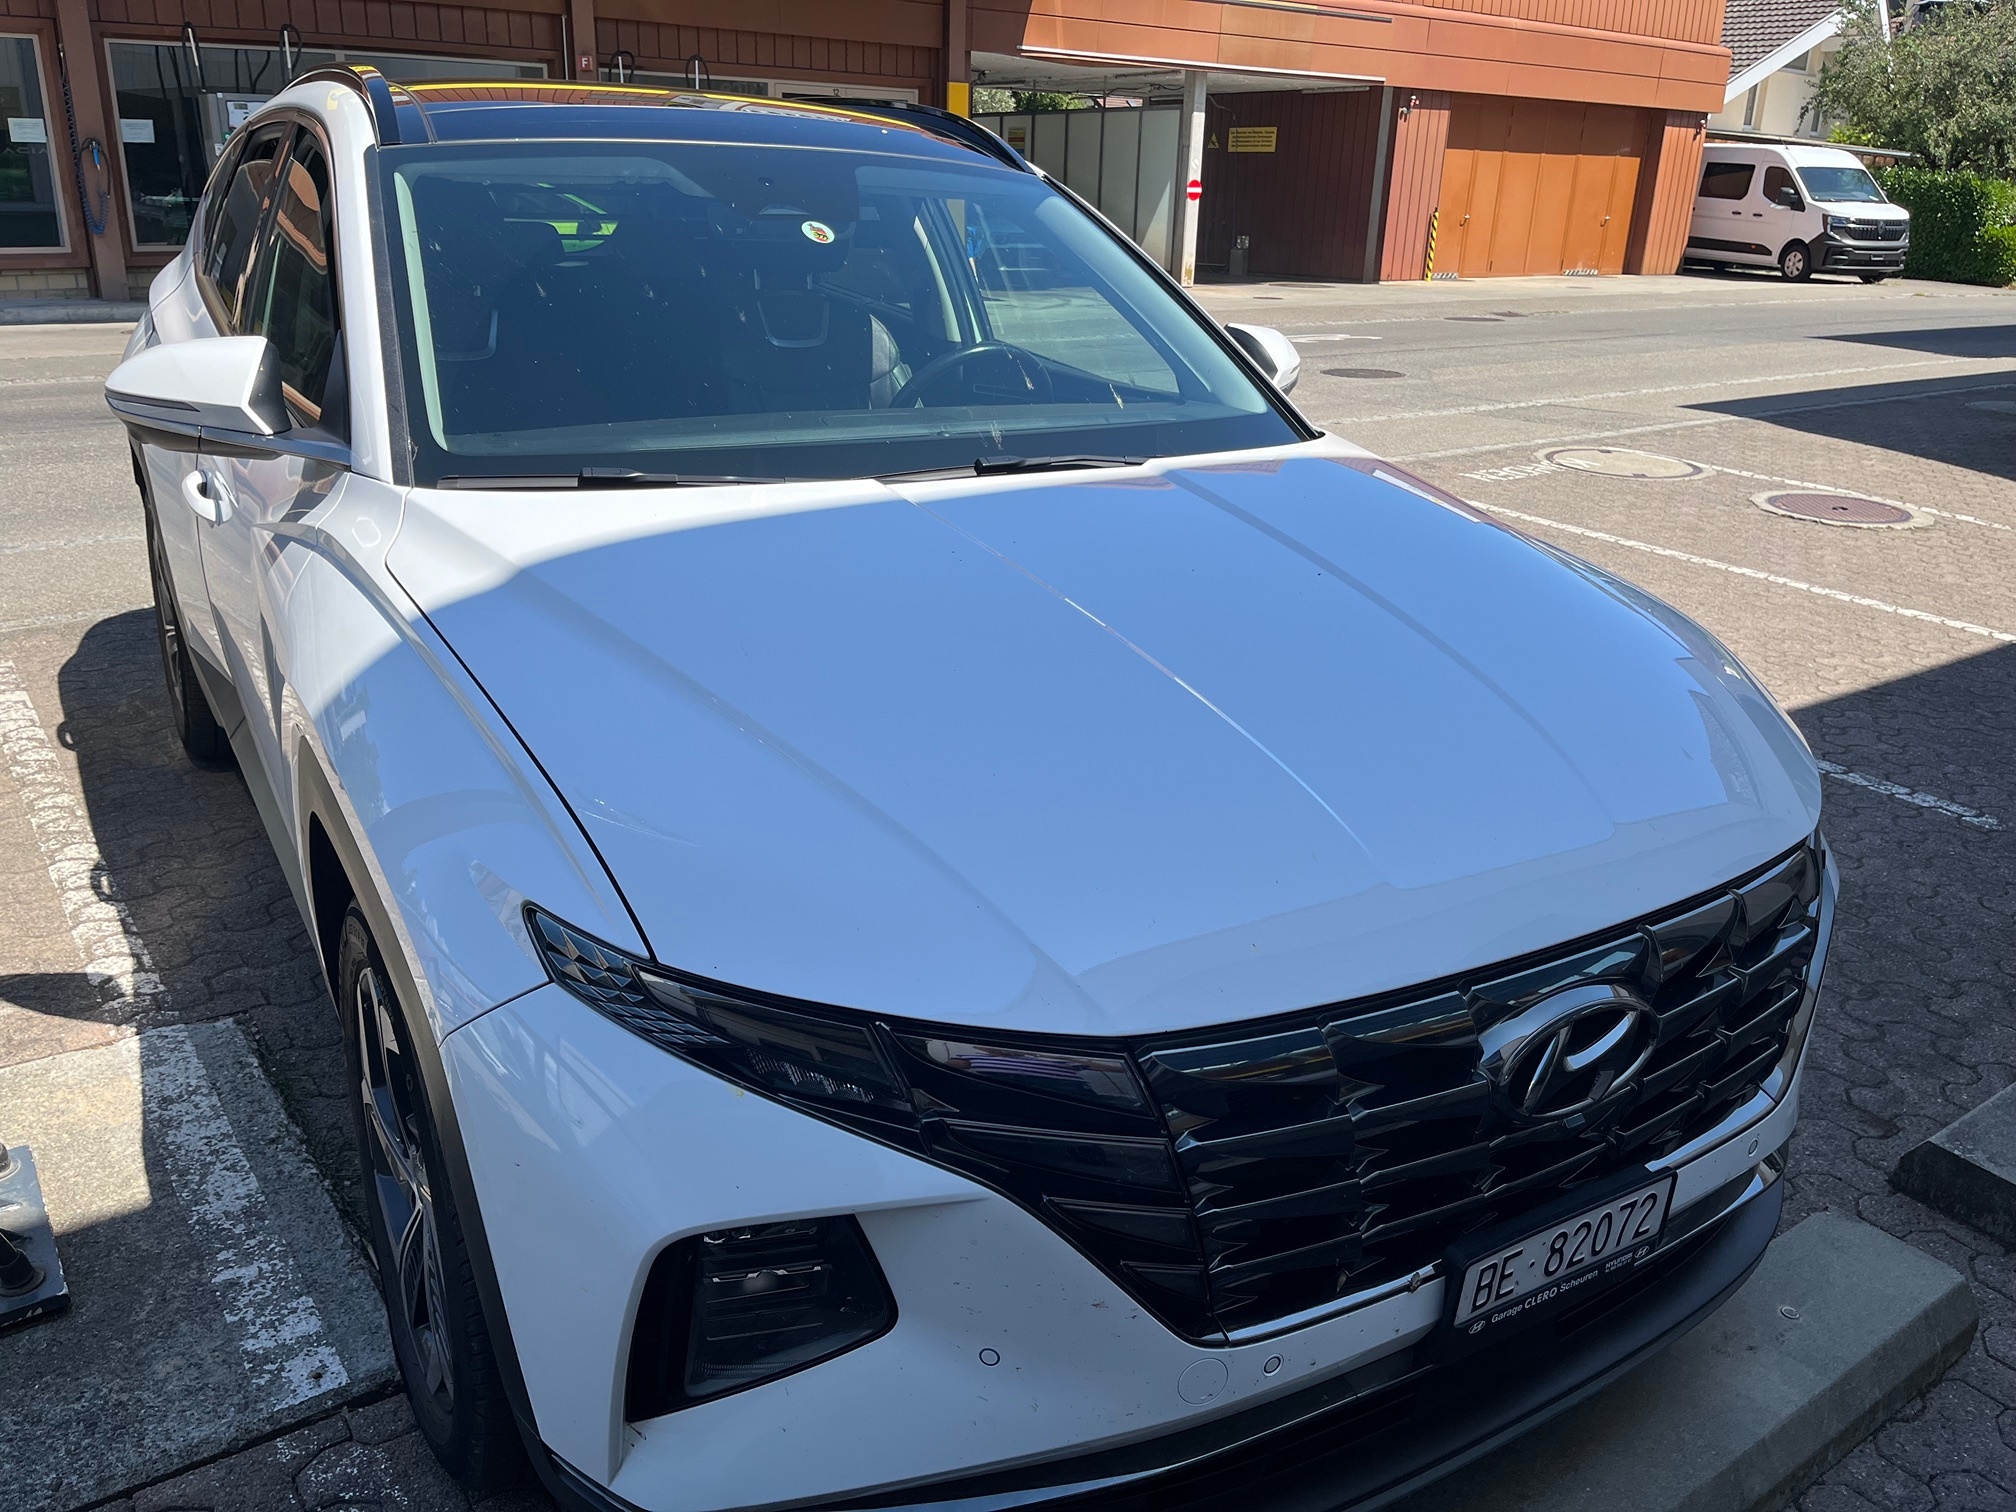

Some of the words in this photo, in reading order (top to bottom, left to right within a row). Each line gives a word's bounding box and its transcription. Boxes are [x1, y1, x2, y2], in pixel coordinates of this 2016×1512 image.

[581, 57, 588, 68] F
[1470, 1248, 1523, 1313] BE
[1543, 1192, 1658, 1278] 82072
[1491, 1304, 1523, 1323] Garage
[1524, 1287, 1558, 1309] CLERO
[1559, 1270, 1598, 1292] Scheuren
